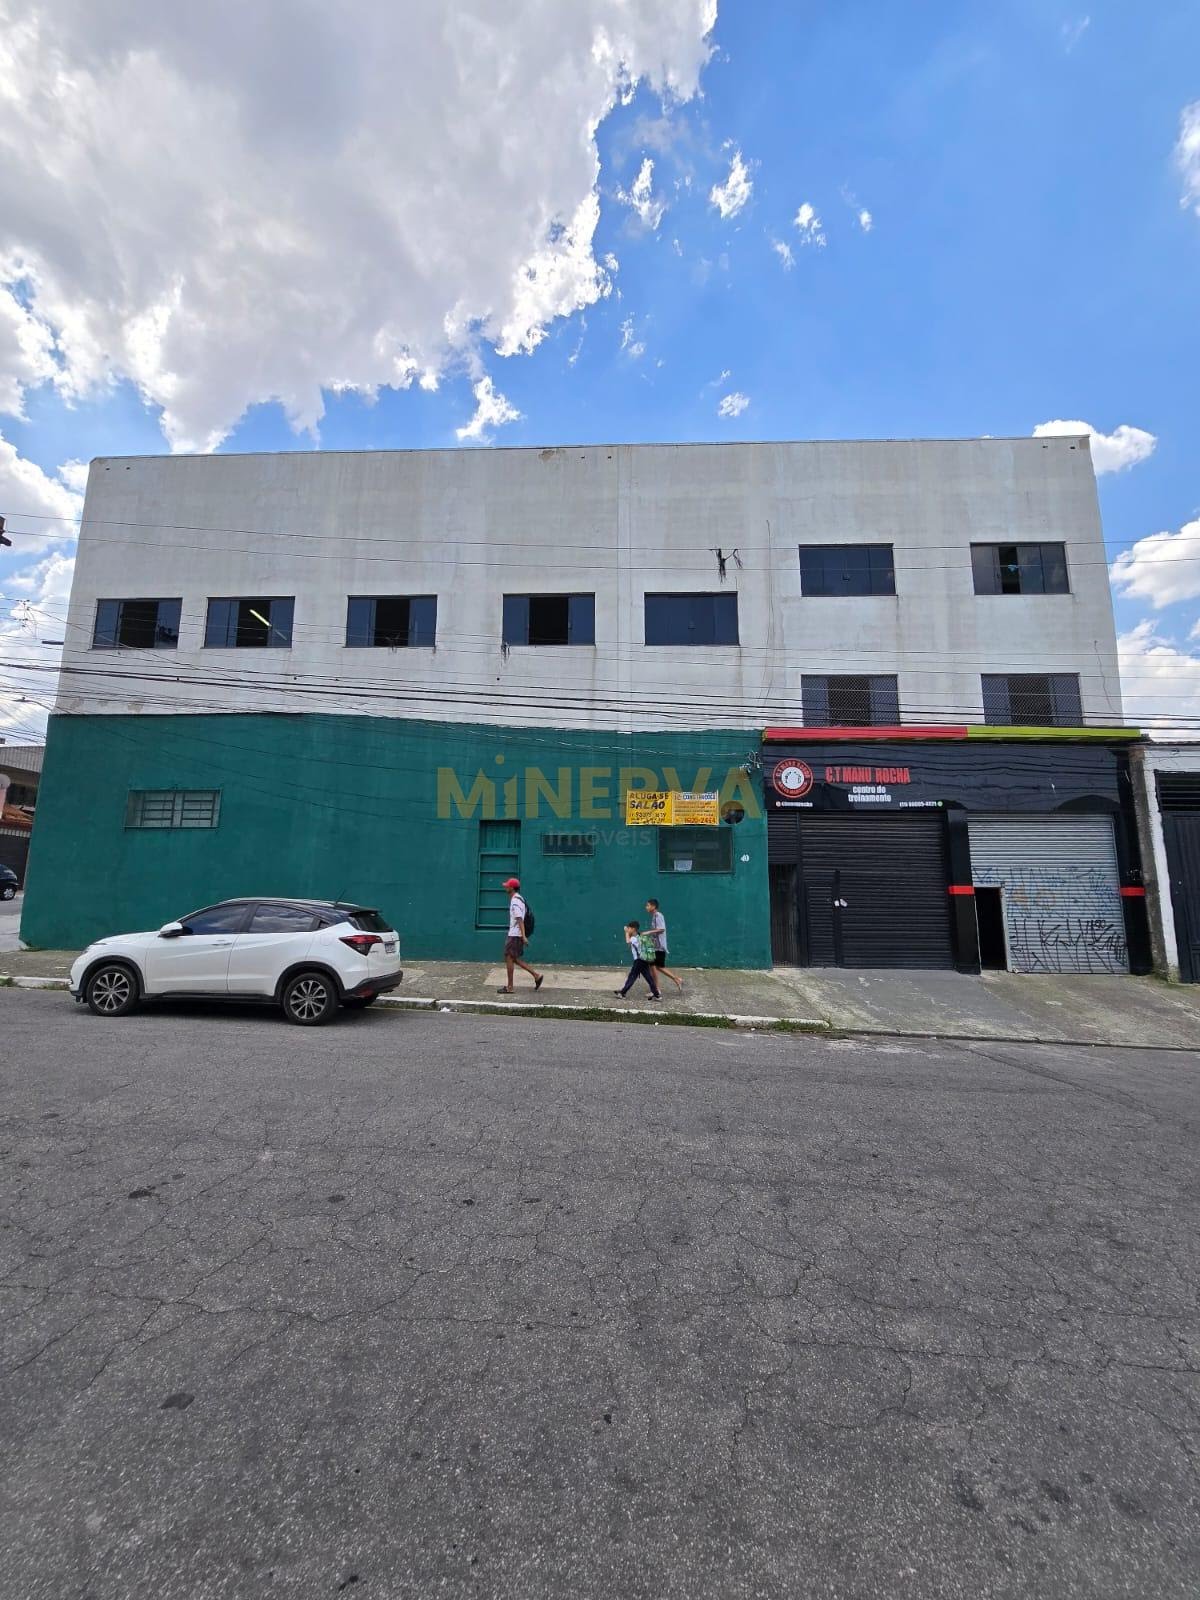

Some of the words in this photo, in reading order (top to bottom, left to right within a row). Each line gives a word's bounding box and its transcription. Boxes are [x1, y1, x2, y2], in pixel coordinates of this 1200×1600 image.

[843, 766, 872, 784] MANU
[875, 767, 911, 784] ROCHA
[852, 785, 876, 794] centro
[848, 794, 892, 802] treinamento
[629, 800, 666, 810] SALÃO
